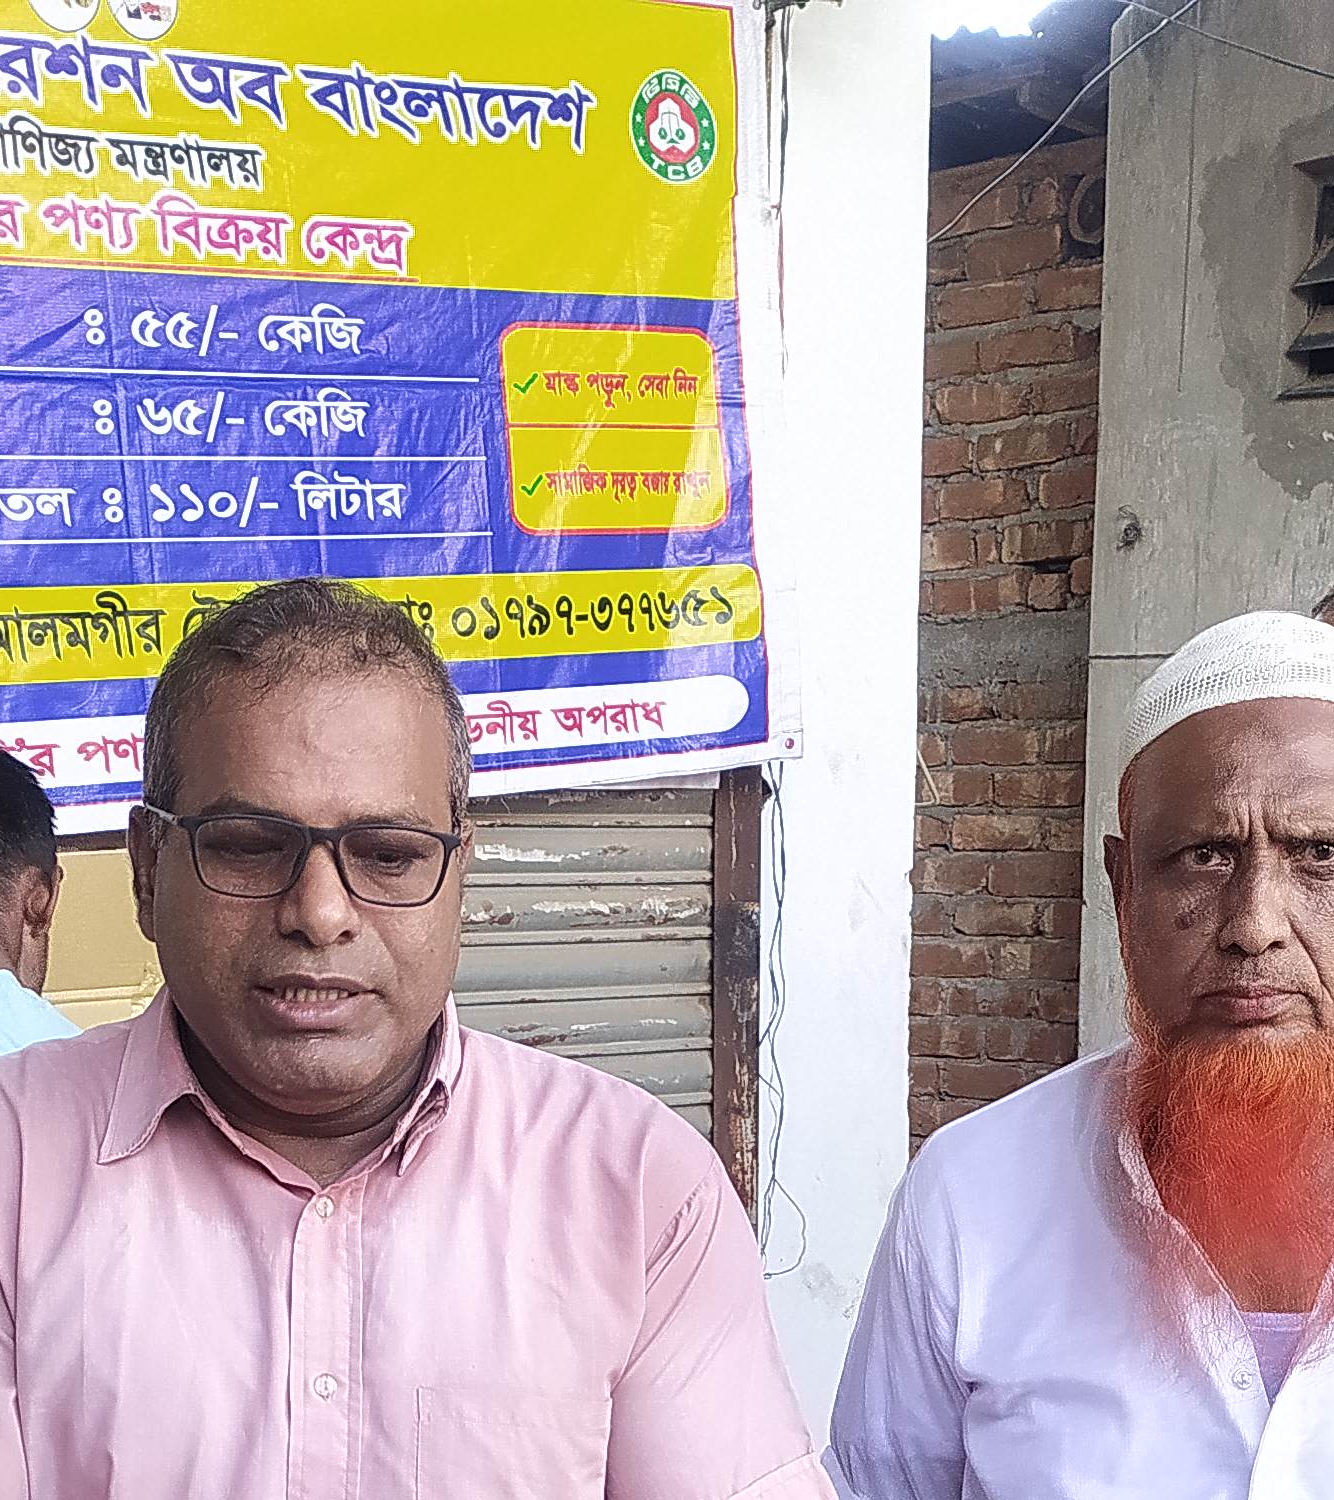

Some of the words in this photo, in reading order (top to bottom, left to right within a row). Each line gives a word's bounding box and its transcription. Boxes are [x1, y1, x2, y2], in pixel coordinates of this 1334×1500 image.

[172, 56, 286, 124] অব
[305, 65, 591, 152] বাংলাদেশ
[110, 135, 262, 188] মন্ত্রণালয়
[650, 153, 703, 180] TCB
[43, 200, 135, 254] পণ্য
[156, 197, 290, 260] বিক্রয়
[304, 219, 414, 274] কেন্দ্র
[257, 303, 366, 356] কেজি
[638, 373, 671, 400] সেবা
[673, 366, 699, 400] নিন
[265, 386, 371, 441] কেজি
[290, 472, 407, 524] লিটার
[545, 463, 607, 496] সামাজিক
[450, 583, 736, 645] ০১৭৯৭-৩৭৭৬৫১
[550, 697, 666, 742] অপরাধ
